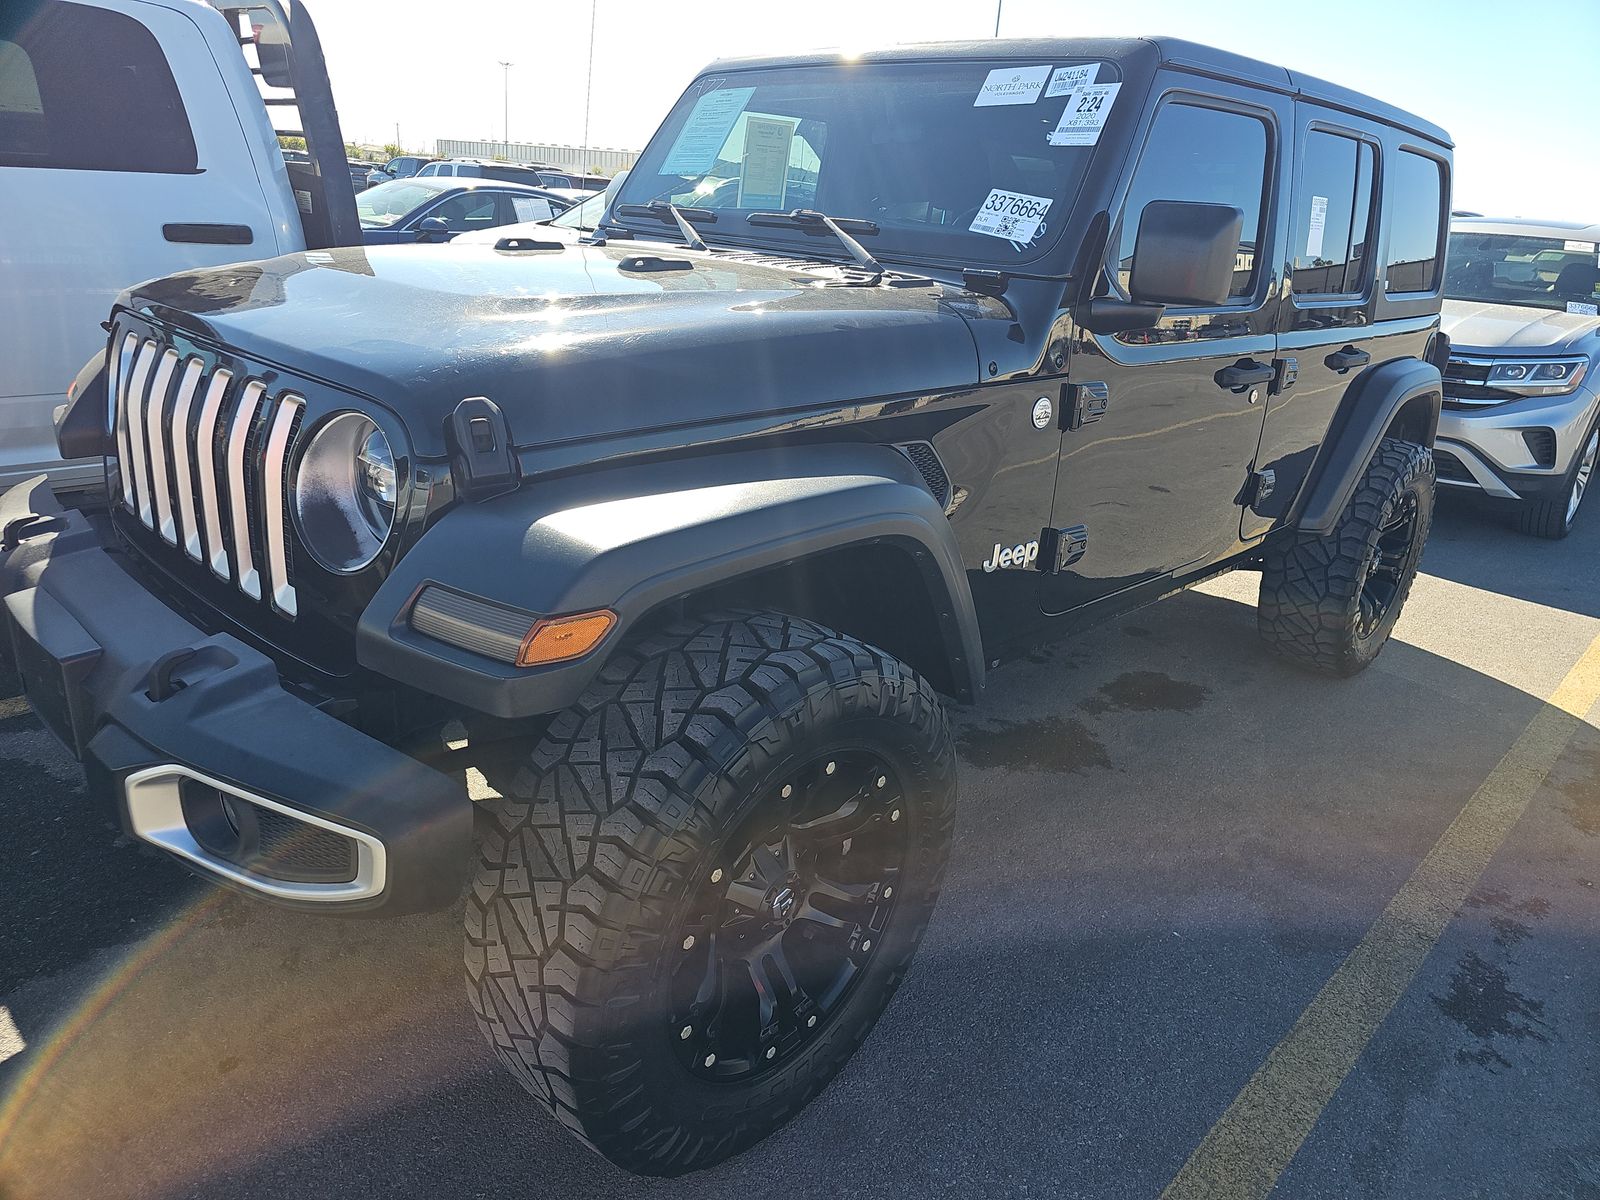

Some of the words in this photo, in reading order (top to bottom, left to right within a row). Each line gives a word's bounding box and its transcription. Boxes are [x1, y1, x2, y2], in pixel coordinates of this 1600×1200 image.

[982, 83, 1017, 93] NORTH
[1018, 80, 1045, 90] PARK
[1076, 96, 1105, 113] 2:24
[1076, 112, 1097, 120] 2020
[985, 193, 1049, 220] 3376664
[982, 540, 1039, 573] Jeep
